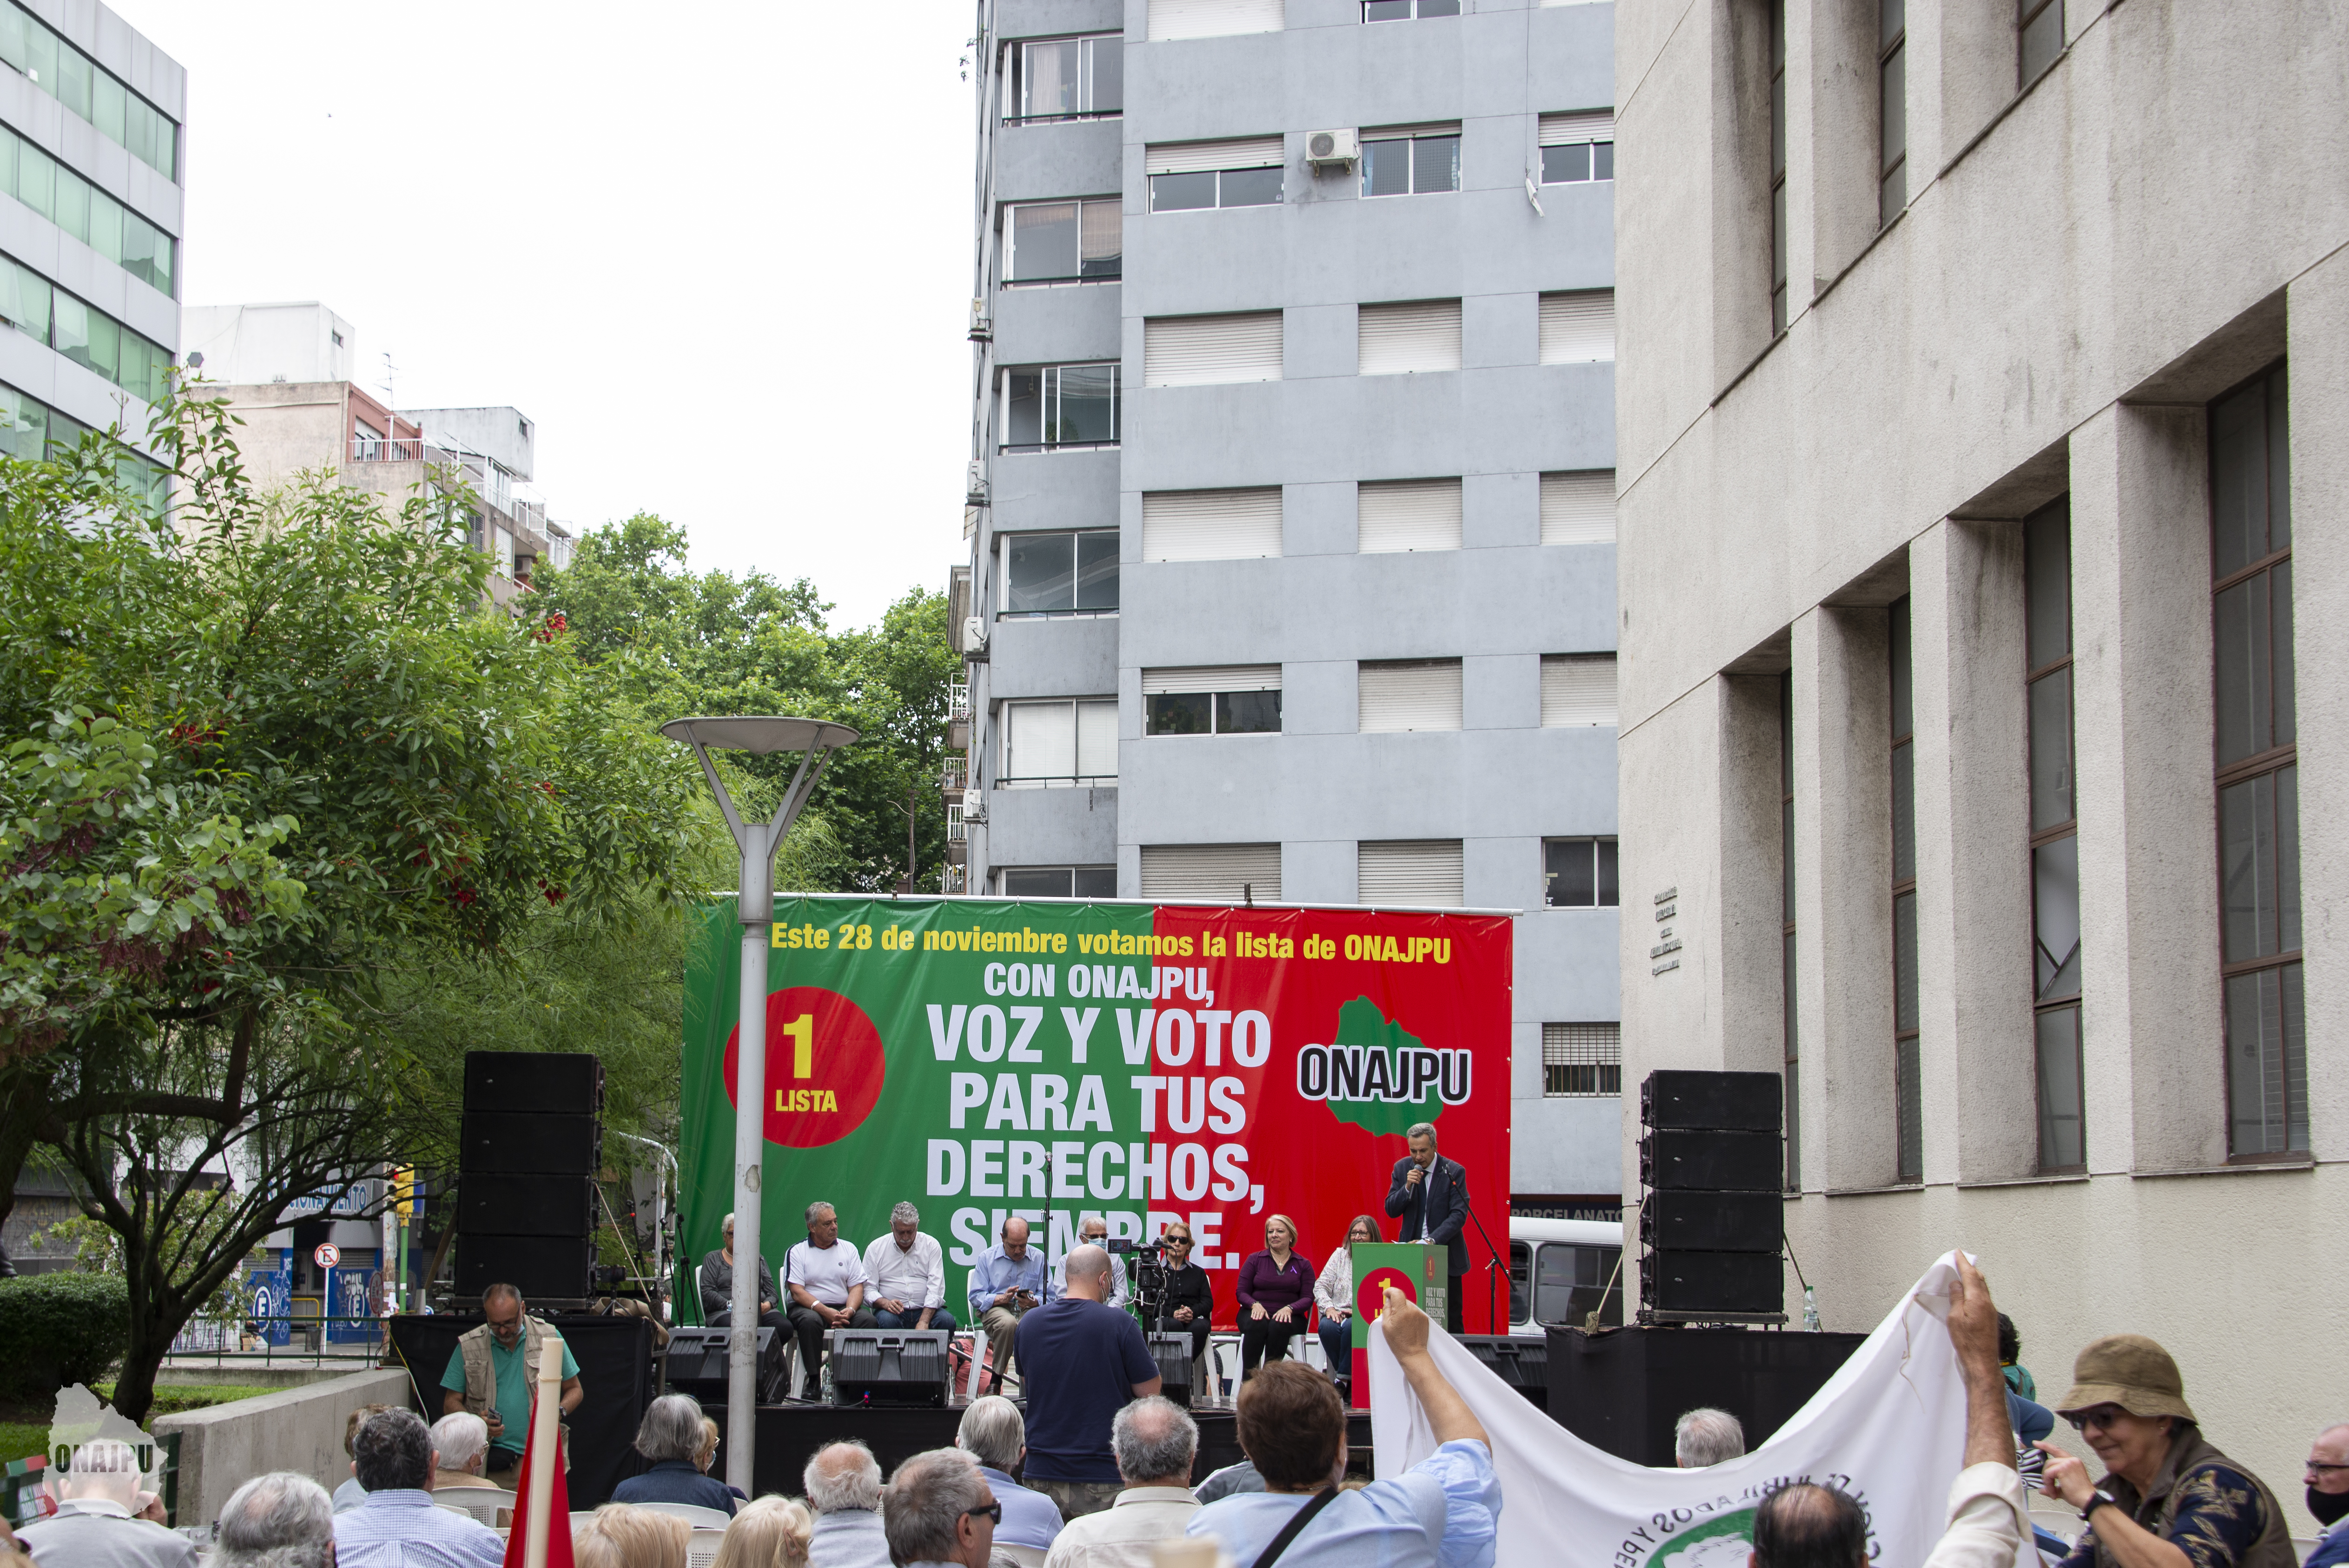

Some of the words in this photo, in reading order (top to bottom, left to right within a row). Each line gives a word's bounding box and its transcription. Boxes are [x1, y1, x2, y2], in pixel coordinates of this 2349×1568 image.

[772, 922, 830, 949] Este
[839, 924, 872, 950] 28
[881, 925, 915, 951] de
[924, 926, 1067, 954] noviembre
[1077, 929, 1194, 956] votamos
[1203, 931, 1226, 957] la
[1236, 932, 1294, 958] lista
[1303, 934, 1336, 960] de
[1345, 934, 1451, 964] ONAJPU
[984, 962, 1055, 997] CON
[1068, 964, 1214, 1008] ONAJPU,
[783, 1014, 813, 1079] 1
[926, 1004, 1043, 1063] VOZ
[1060, 1007, 1101, 1063] Y
[1115, 1008, 1271, 1067] VOTO
[1297, 1044, 1471, 1105] ONAJPU
[776, 1089, 838, 1112] LISTA
[950, 1072, 1113, 1132] PARA
[1131, 1075, 1246, 1134] TUS
[927, 1139, 1264, 1214] DERECHOS,
[258, 1297, 267, 1322] E
[1426, 1297, 1436, 1307] PARA
[1433, 1287, 1436, 1297] Y
[1436, 1287, 1445, 1298] VOTO
